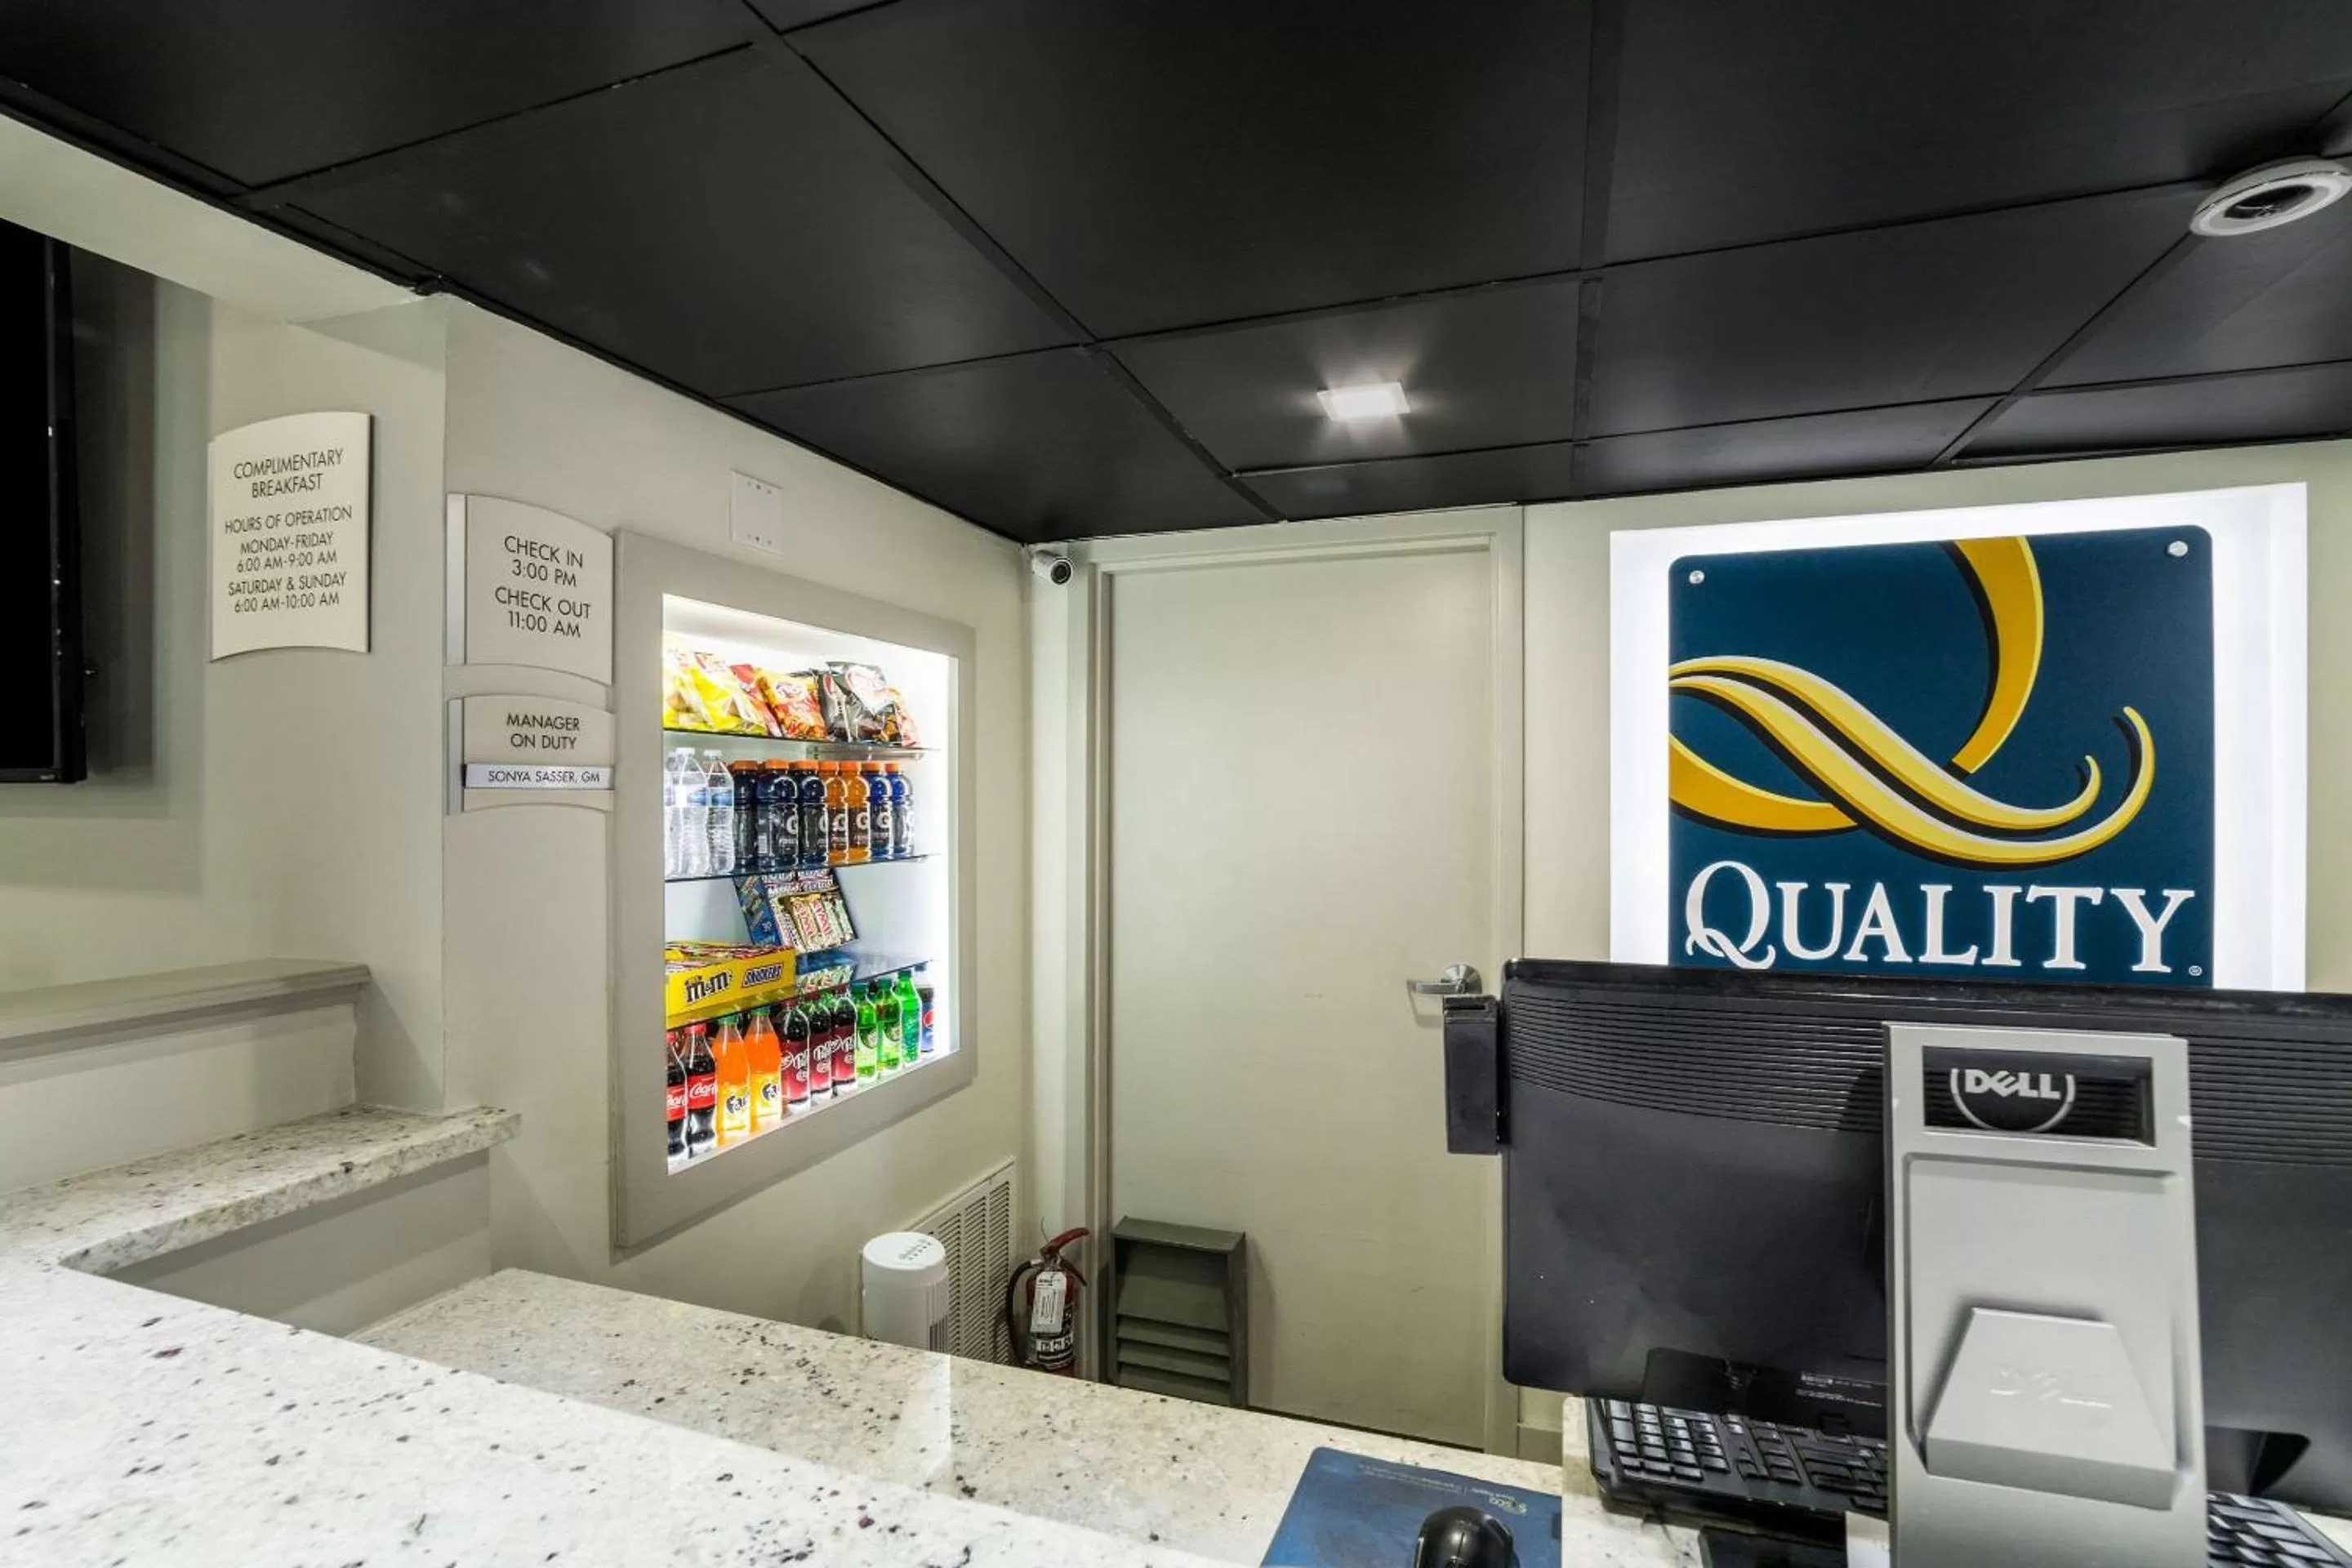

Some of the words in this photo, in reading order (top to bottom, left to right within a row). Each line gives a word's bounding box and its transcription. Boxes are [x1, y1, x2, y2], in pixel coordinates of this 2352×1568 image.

[234, 448, 344, 479] COMPLIMENTARY
[252, 473, 324, 498] BREAKFAST
[225, 516, 262, 534] HOURS
[265, 514, 282, 529] OF
[285, 505, 352, 527] OPERATION
[240, 532, 334, 555] MONDAY-FRIDAY
[504, 535, 561, 564] CHECK
[566, 550, 583, 569] IN
[236, 557, 261, 572] 6:00
[264, 551, 313, 571] AM-9:00
[317, 550, 337, 565] AM
[512, 559, 548, 581] 3:00
[554, 568, 577, 587] PM
[228, 577, 283, 597] SATURDAY
[286, 576, 295, 591] &
[299, 572, 347, 590] SUNDAY
[234, 597, 258, 613] 6:00
[261, 591, 316, 611] AM-10:00
[319, 591, 340, 607] AM
[495, 586, 552, 612] CHECK
[558, 599, 591, 619] OUT
[508, 610, 547, 632] 11:00
[553, 620, 581, 638] AM
[506, 712, 581, 731] MANAGER
[510, 733, 536, 749] ON
[541, 734, 577, 750] DUTY
[488, 770, 532, 783] SONYA
[581, 771, 600, 783] GM
[1685, 859, 2195, 973] QUALITY
[1964, 1067, 2062, 1101] DELL
